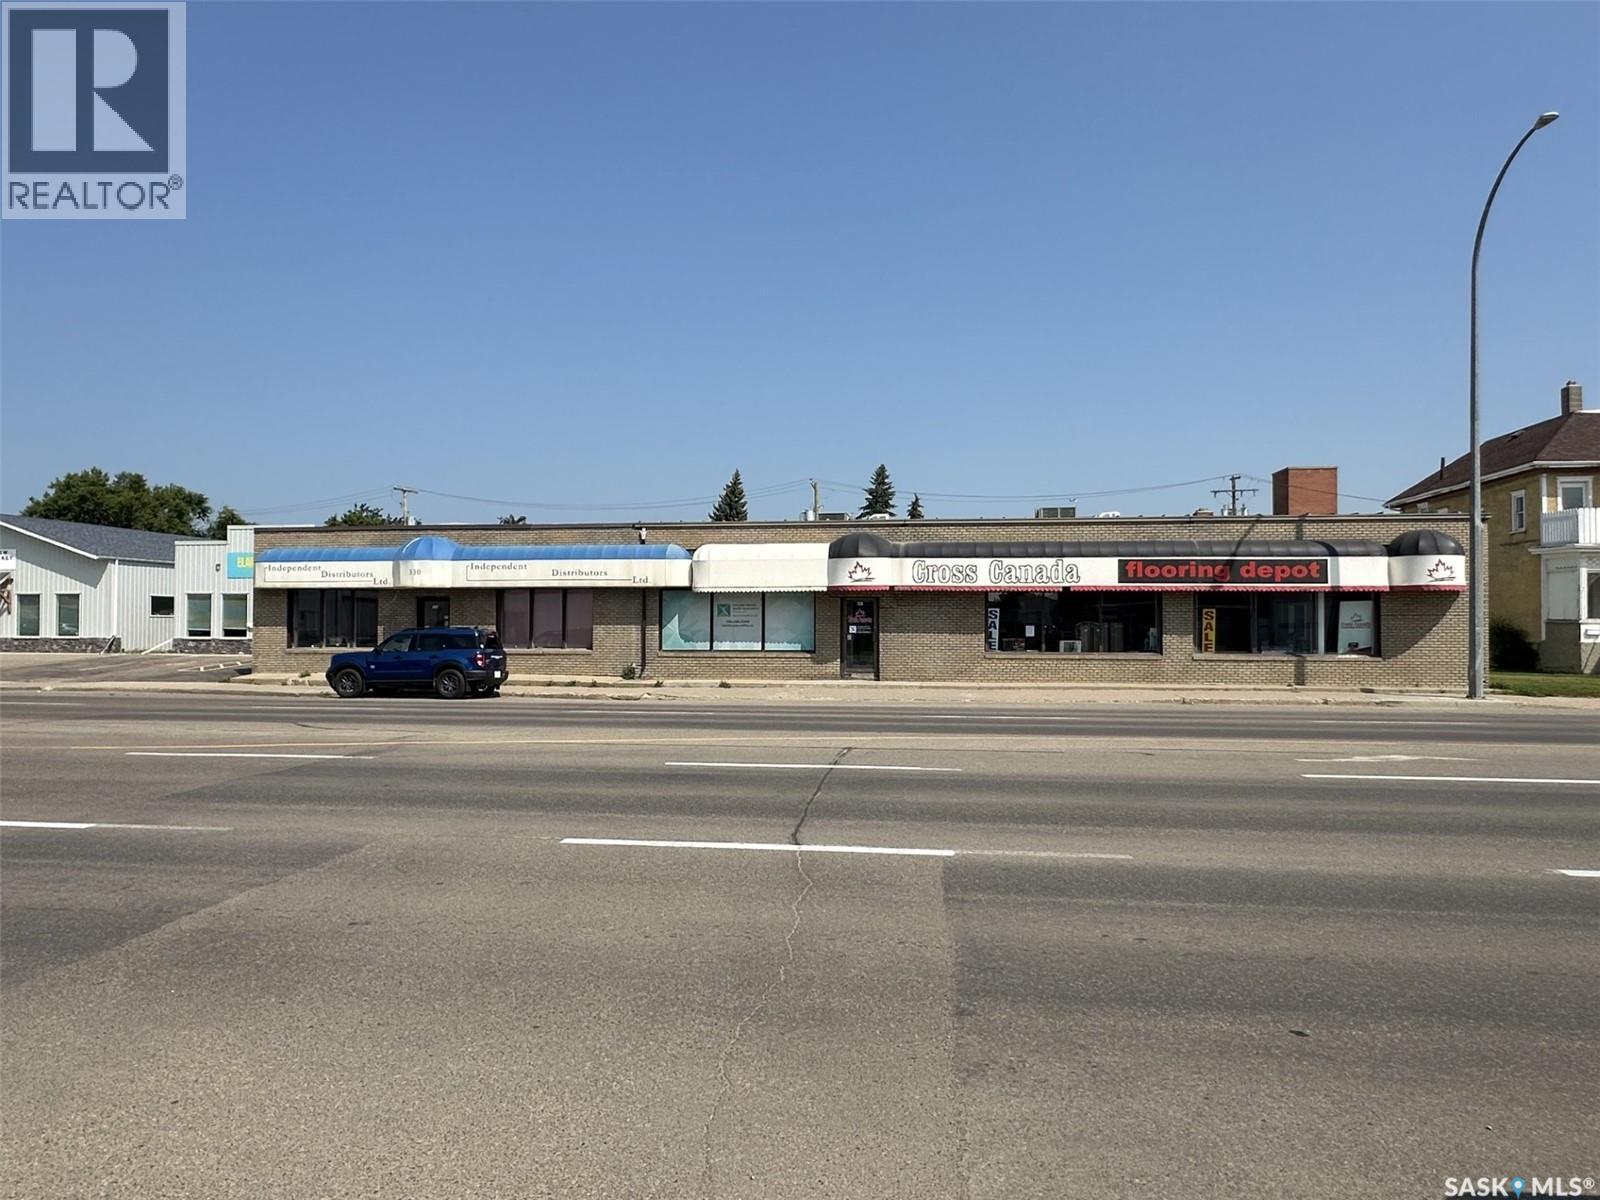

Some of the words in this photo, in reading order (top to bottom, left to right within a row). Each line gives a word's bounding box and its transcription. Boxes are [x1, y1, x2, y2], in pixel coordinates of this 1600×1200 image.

[268, 564, 321, 573] Independent
[321, 570, 374, 578] Distributors
[470, 563, 528, 572] Independent
[551, 568, 608, 577] Distributors
[912, 559, 978, 584] Cross
[989, 559, 1081, 584] Canada
[1125, 560, 1230, 582] flooring
[1239, 560, 1320, 582] depot
[988, 609, 998, 650] SALE
[1204, 610, 1214, 652] SALE
